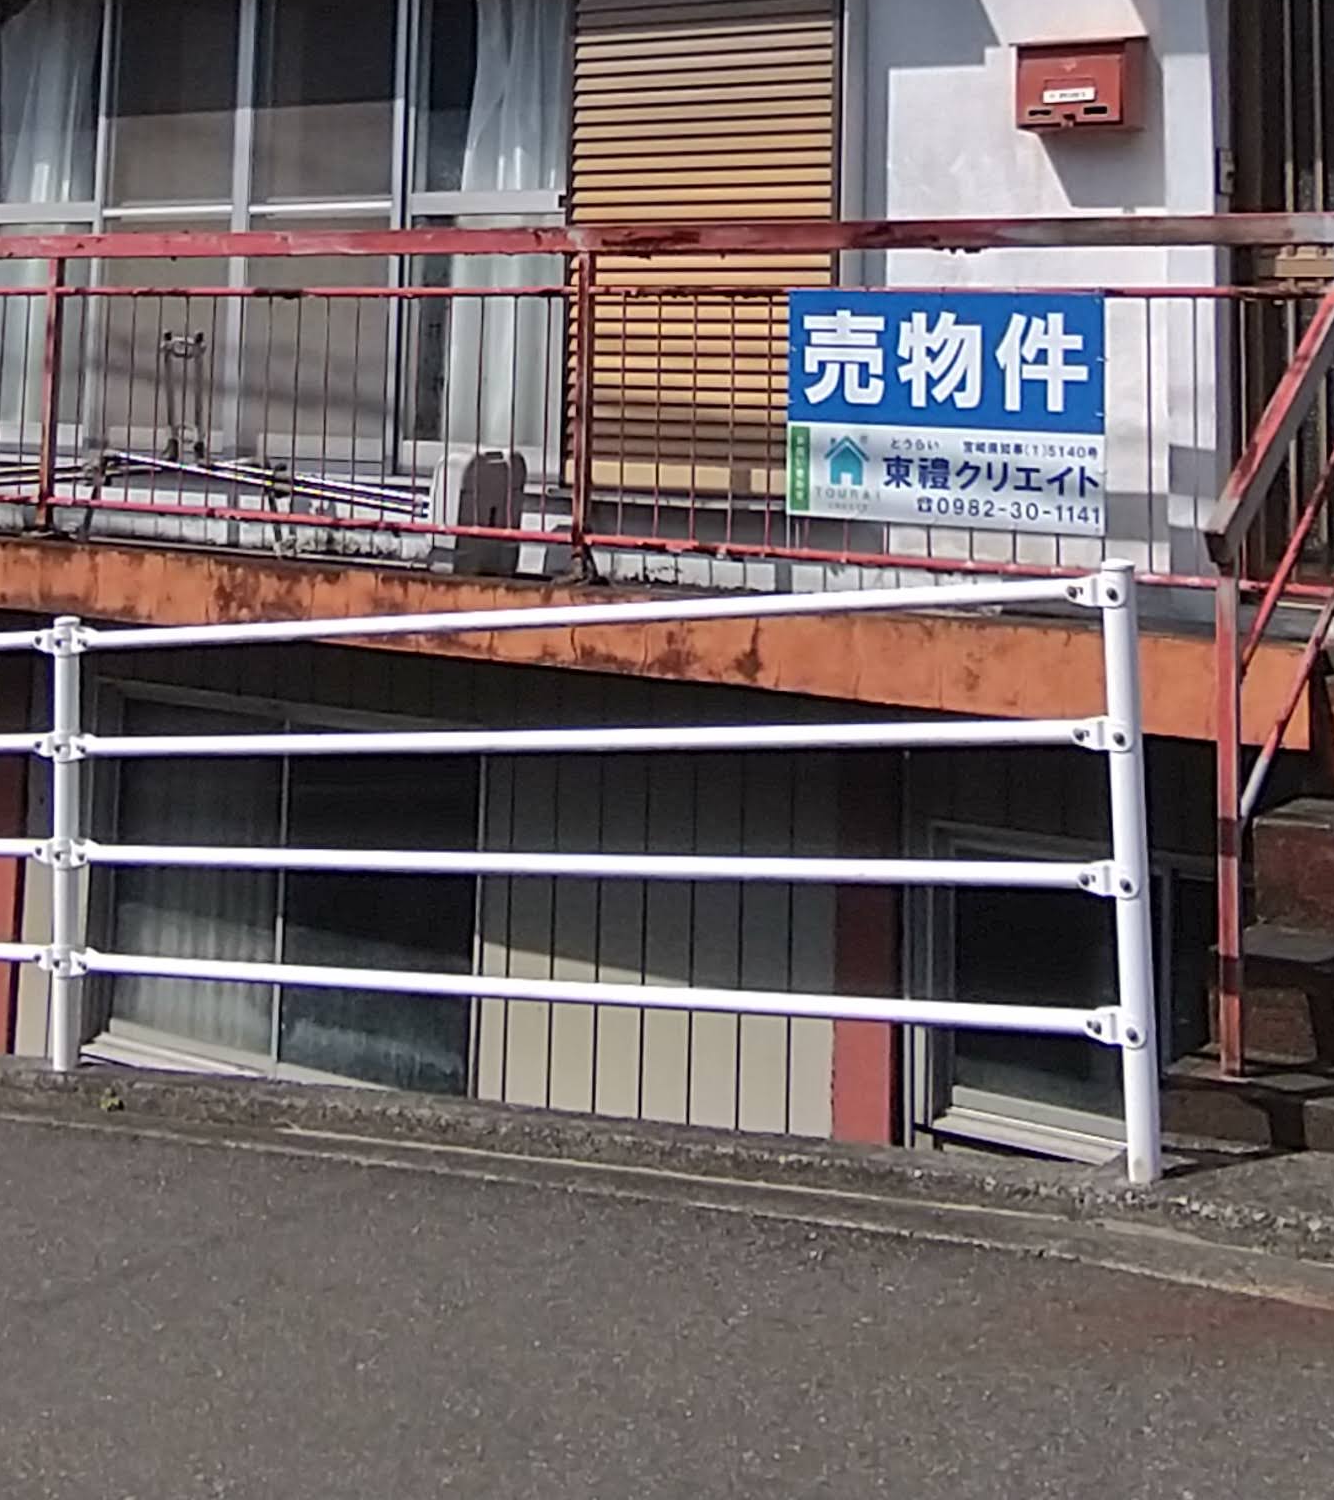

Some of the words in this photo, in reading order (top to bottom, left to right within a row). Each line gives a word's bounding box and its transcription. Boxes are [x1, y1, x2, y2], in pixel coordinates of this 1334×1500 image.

[803, 310, 1088, 413] 売物件
[890, 438, 940, 451] とうらい
[882, 455, 1100, 498] 東禮クリエイト
[937, 497, 1101, 525] 0982-30-1141
